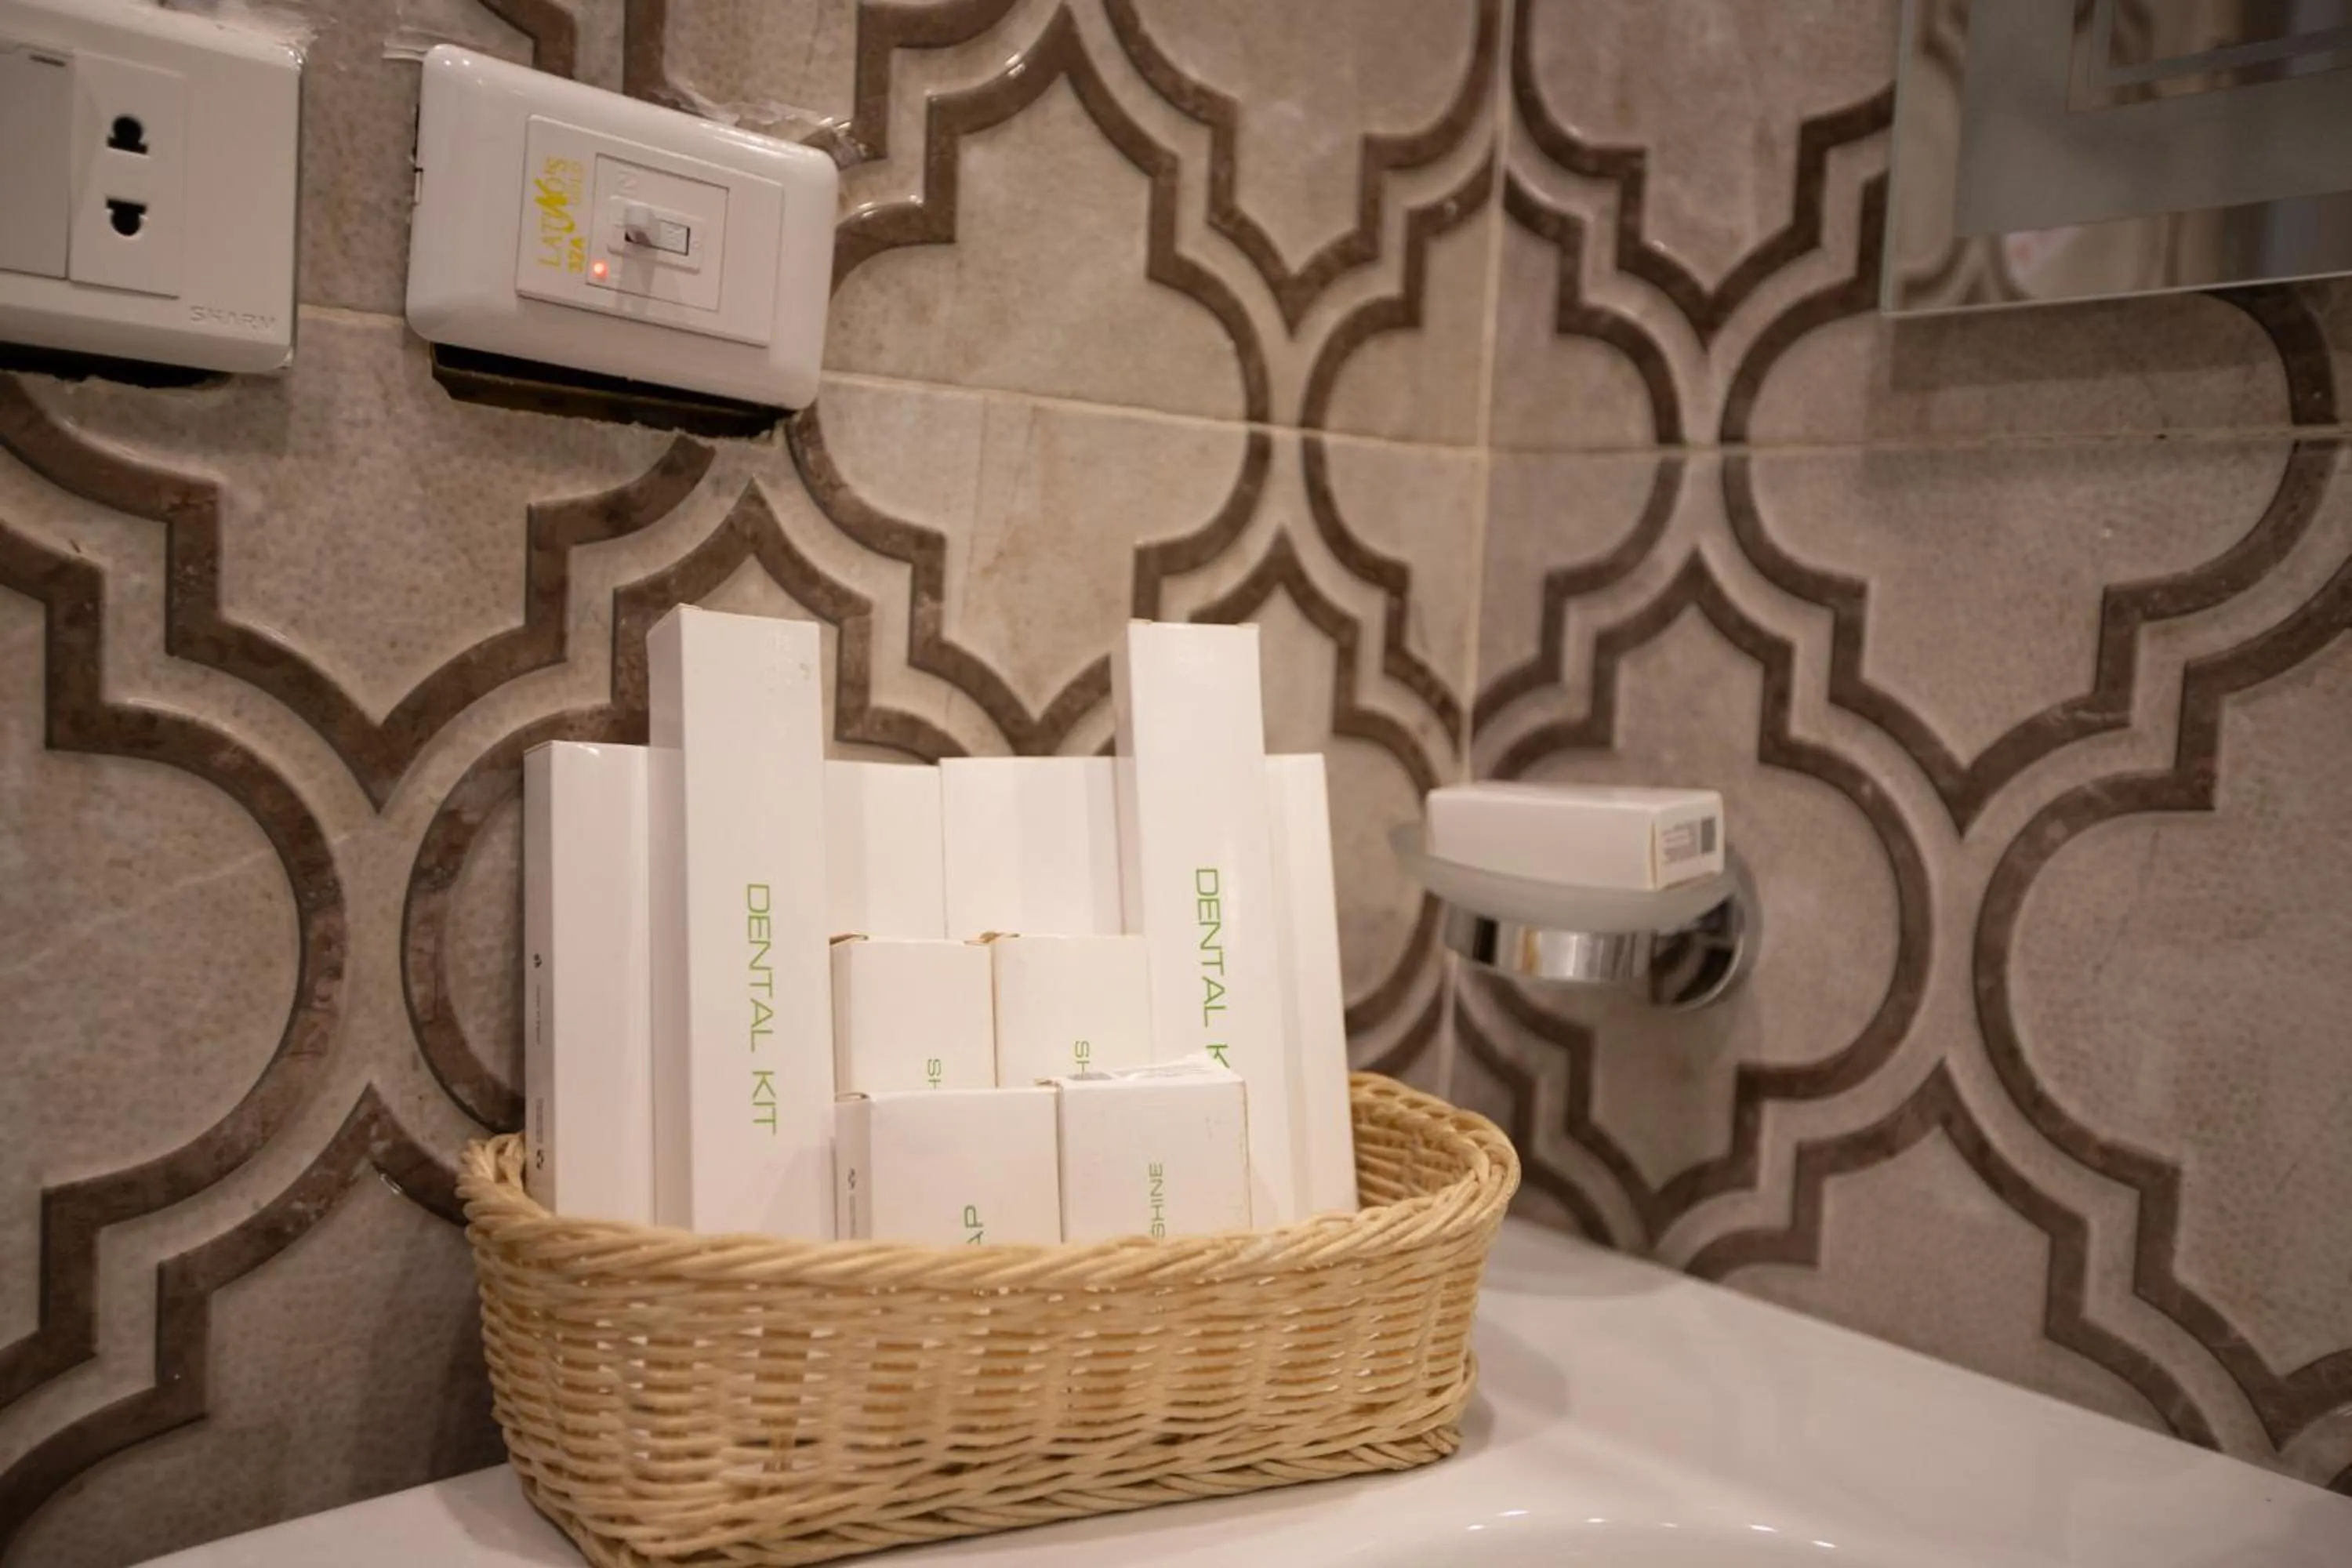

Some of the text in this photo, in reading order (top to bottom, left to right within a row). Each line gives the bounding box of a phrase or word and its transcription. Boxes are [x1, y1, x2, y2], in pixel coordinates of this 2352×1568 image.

[747, 883, 777, 1136] DENTAL KIT
[1196, 868, 1227, 1028] DENTAL
[1149, 1161, 1166, 1239] SHINE
